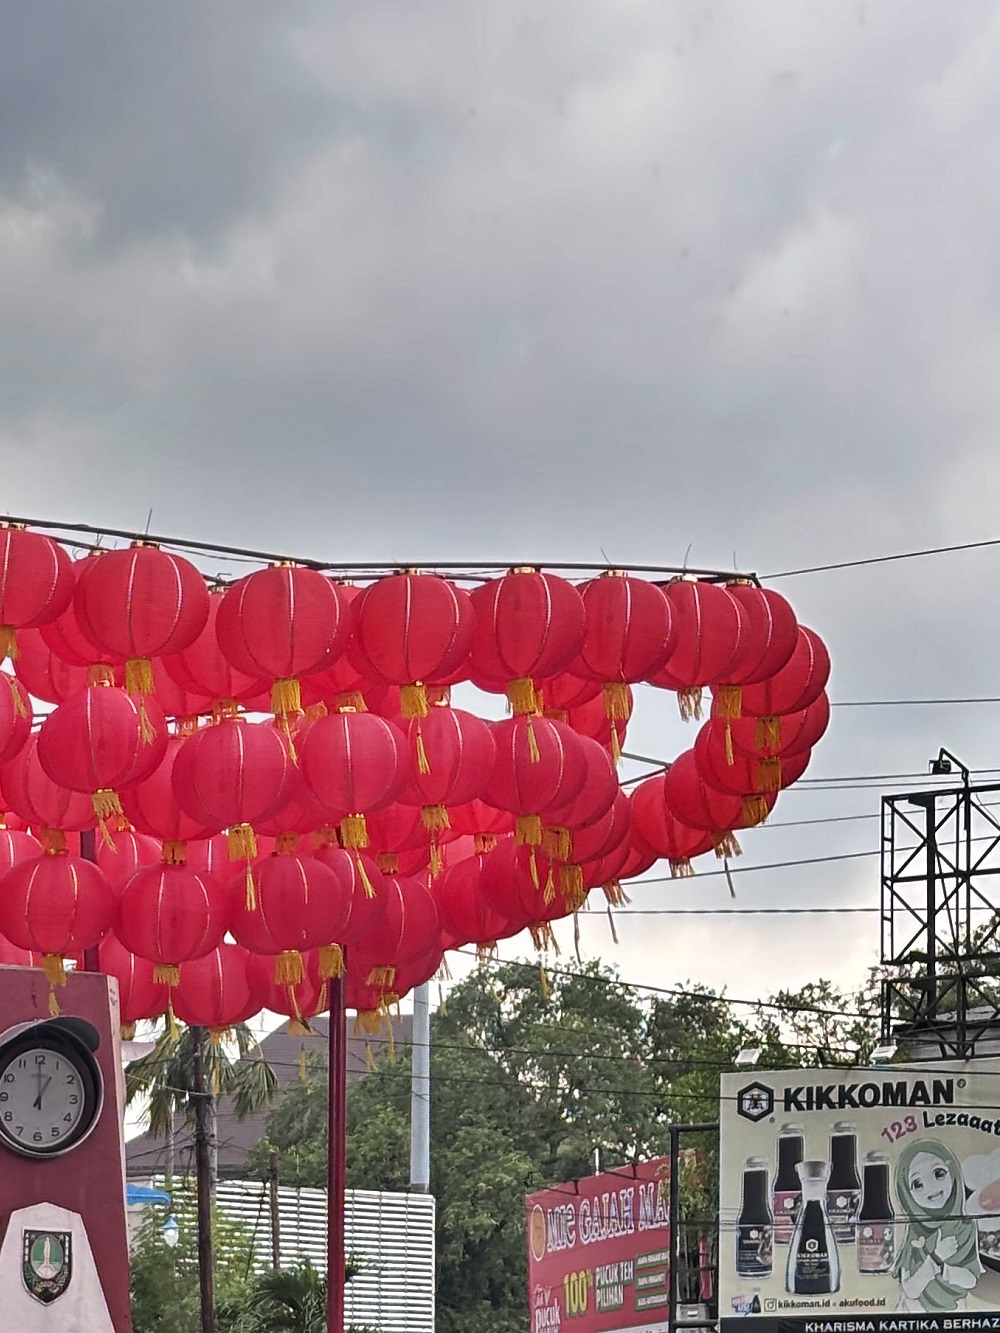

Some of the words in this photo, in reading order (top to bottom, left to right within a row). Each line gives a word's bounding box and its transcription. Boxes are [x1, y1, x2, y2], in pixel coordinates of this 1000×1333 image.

[19, 1060, 27, 1069] 11
[35, 1055, 46, 1065] 12
[4, 1073, 16, 1083] 10
[66, 1075, 75, 1085] 2
[0, 1092, 9, 1102] 9
[69, 1094, 78, 1105] 3
[784, 1079, 955, 1112] KIKKOMAN
[4, 1111, 13, 1122] 8
[63, 1112, 72, 1123] 4
[16, 1126, 24, 1136] 7
[51, 1127, 60, 1137] 5
[881, 1115, 918, 1143] 123
[33, 1132, 43, 1142] 6
[639, 1182, 670, 1232] MA
[595, 1263, 619, 1287] PUCUK
[804, 1321, 874, 1333] KHARISMA
[879, 1319, 939, 1332] KARTIKA
